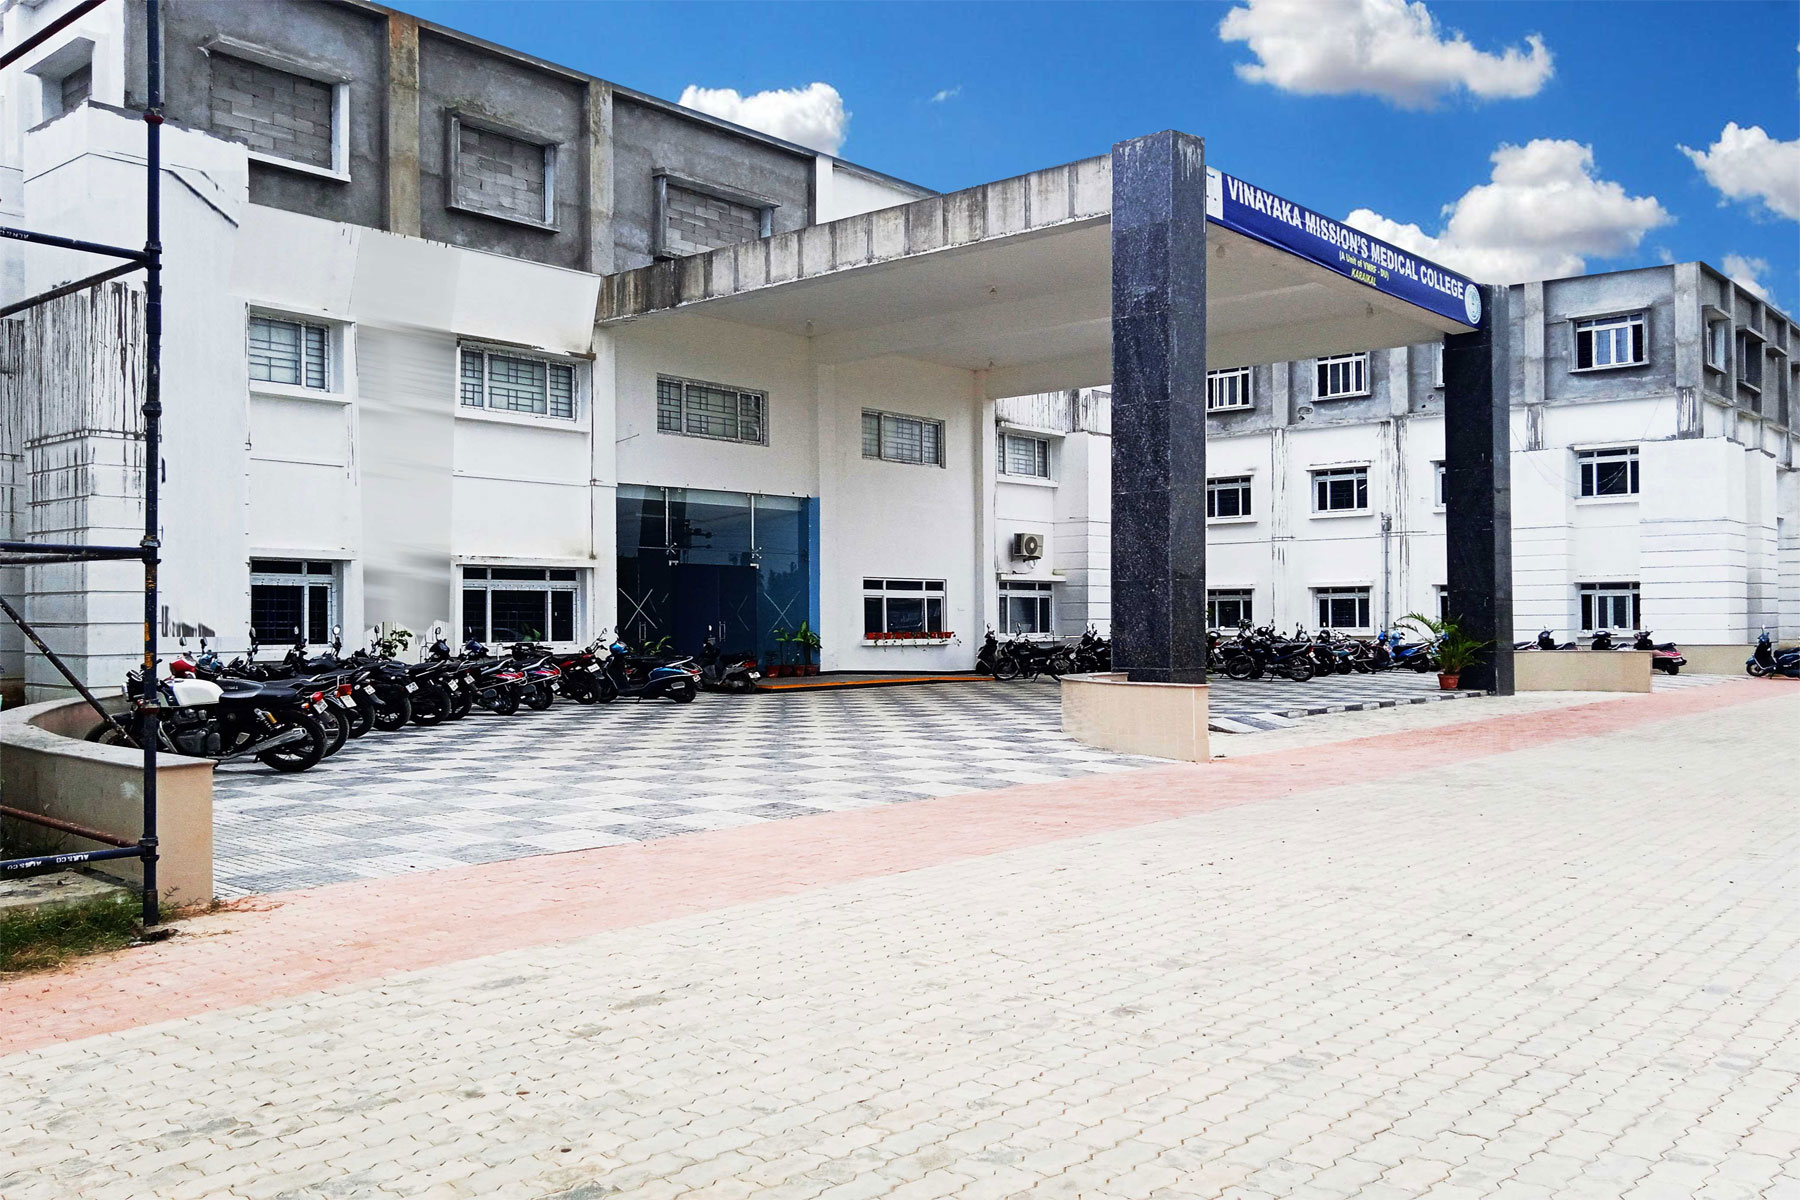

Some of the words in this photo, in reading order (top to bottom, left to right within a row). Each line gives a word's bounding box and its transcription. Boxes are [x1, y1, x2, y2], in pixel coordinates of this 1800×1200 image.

[1227, 175, 1303, 229] VINAYAKA
[1304, 211, 1369, 259] MISSION'S
[1371, 242, 1419, 281] MEDICAL
[1420, 265, 1464, 300] COLLEGE
[1346, 253, 1357, 266] Unit
[1351, 268, 1377, 286] KARAIKAL
